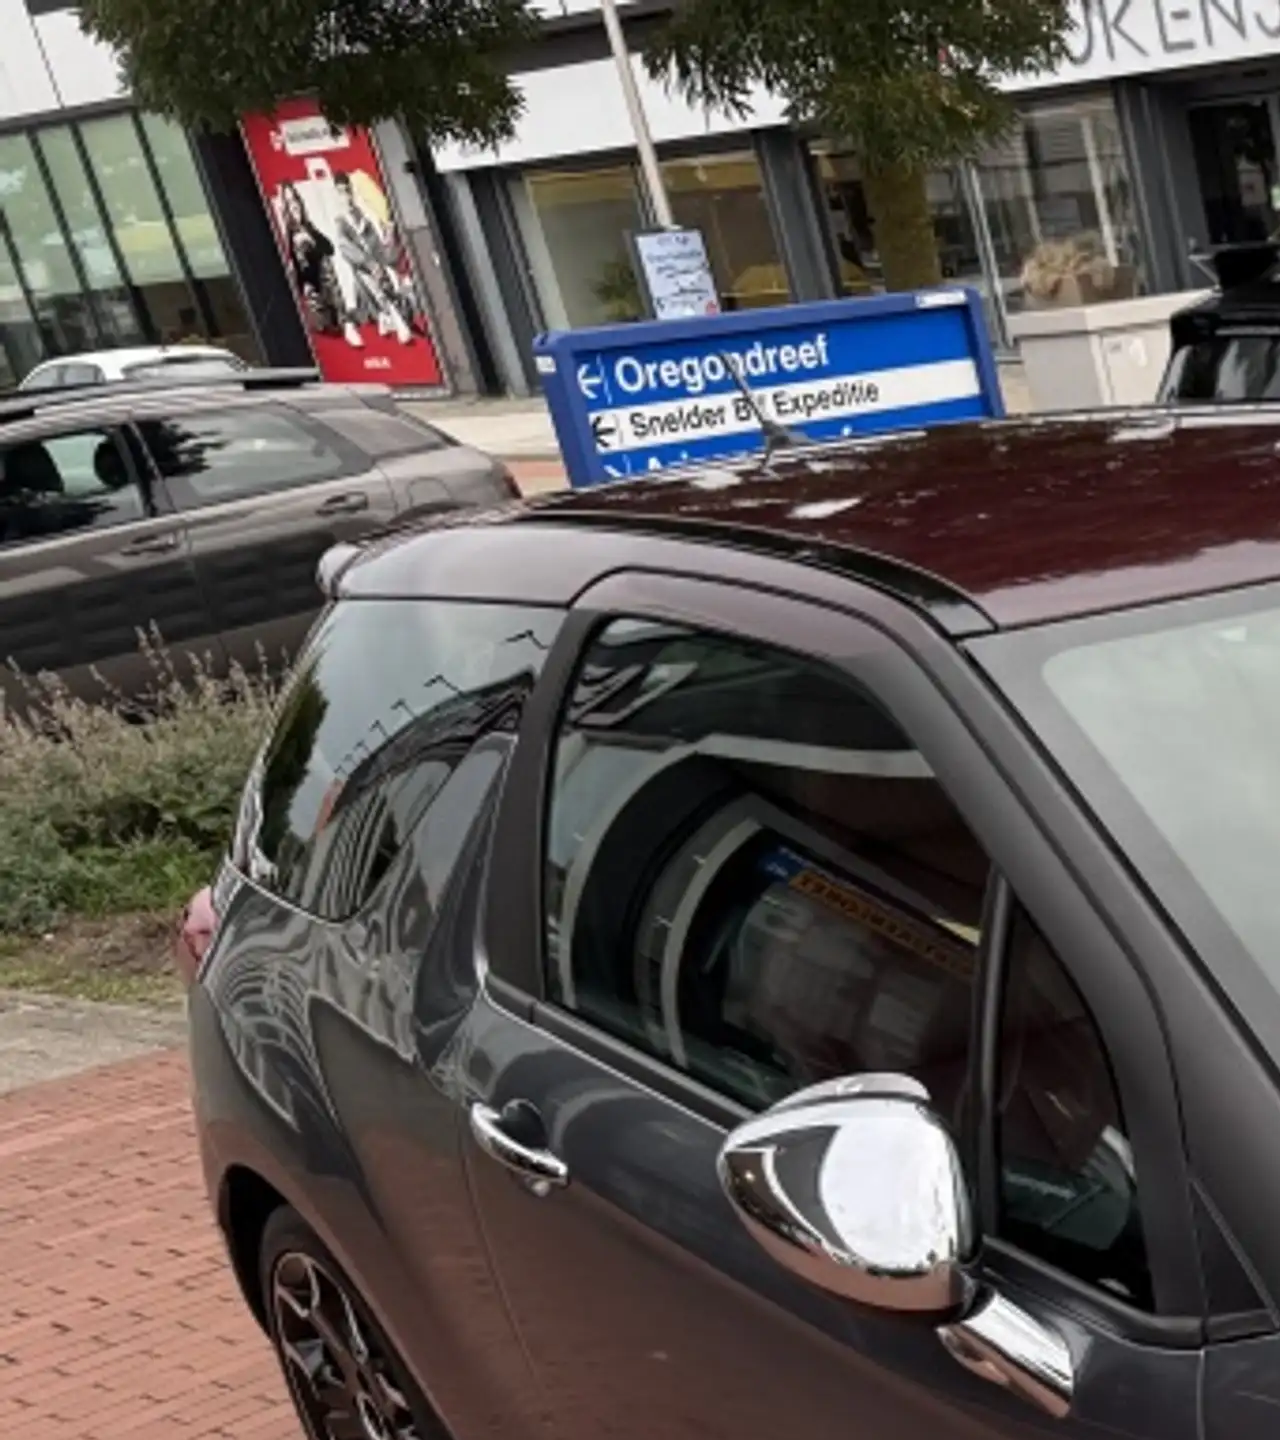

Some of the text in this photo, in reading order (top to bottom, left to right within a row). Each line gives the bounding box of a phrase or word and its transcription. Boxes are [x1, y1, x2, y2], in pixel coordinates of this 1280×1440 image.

[615, 334, 829, 393] Oregondreef
[630, 404, 726, 437] Snelder
[773, 380, 879, 418] Expeditie
